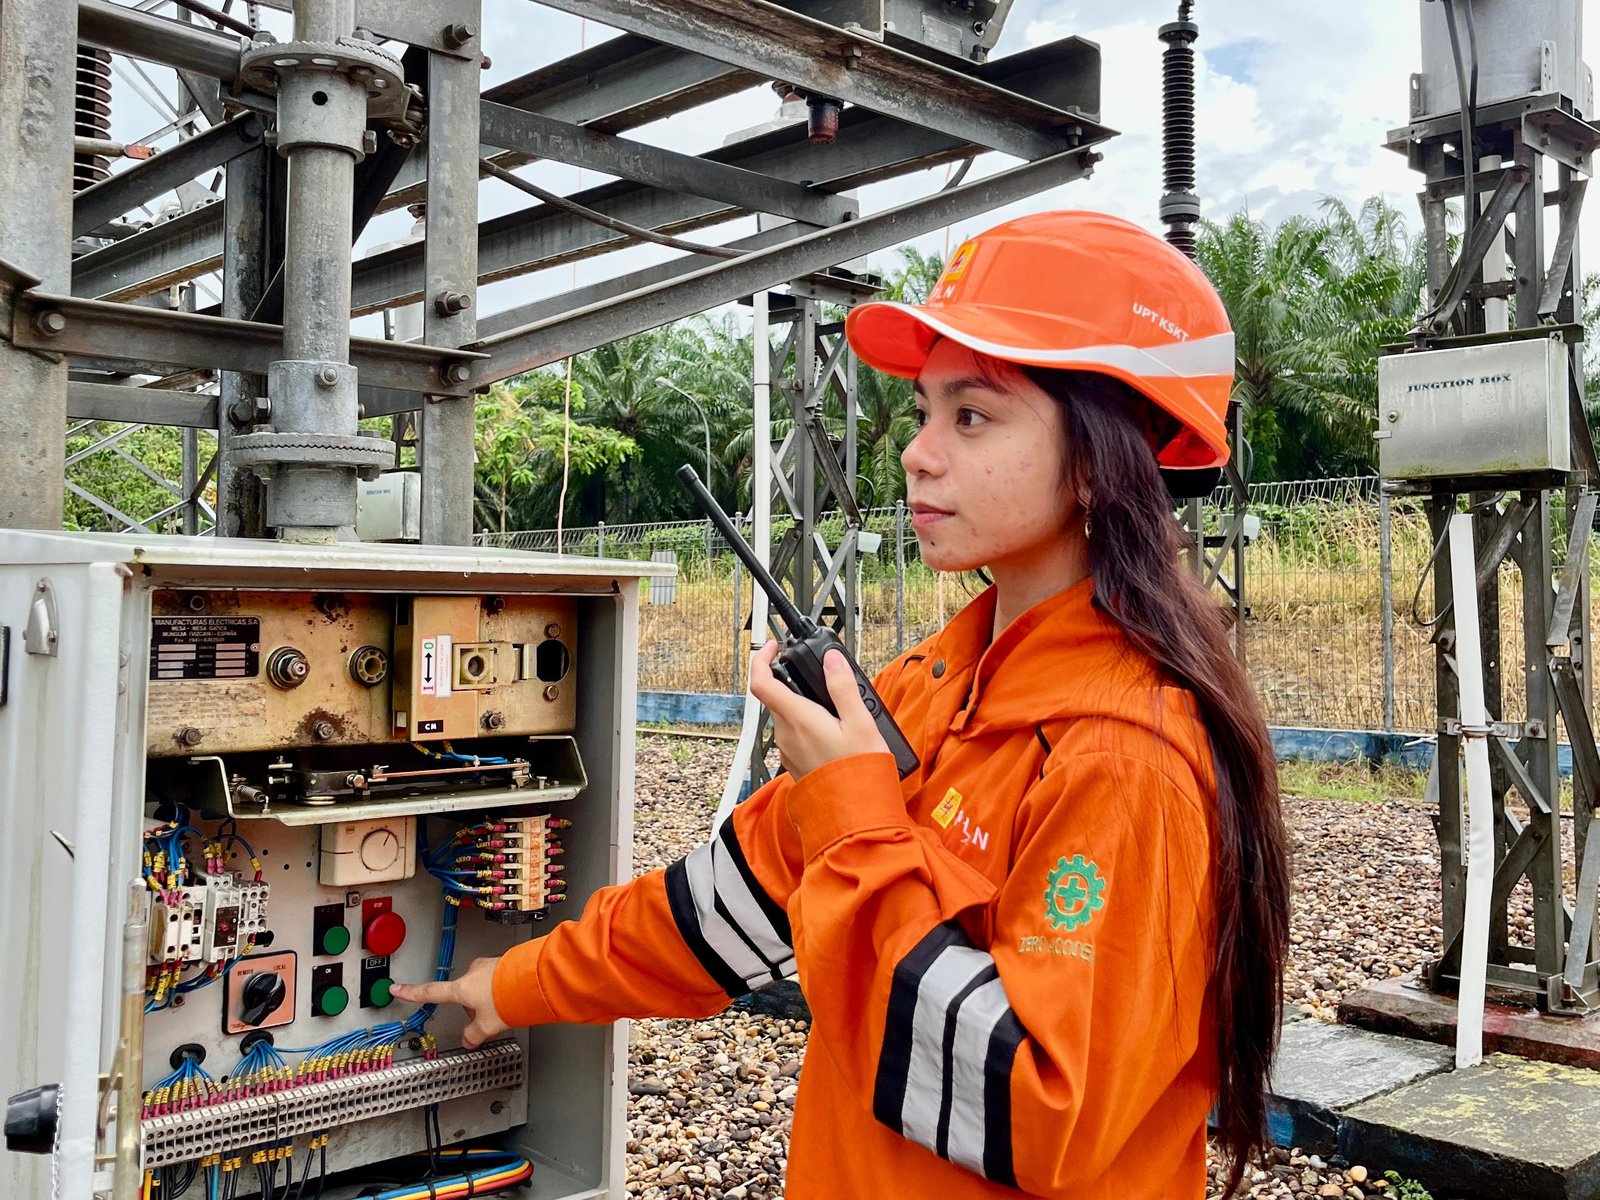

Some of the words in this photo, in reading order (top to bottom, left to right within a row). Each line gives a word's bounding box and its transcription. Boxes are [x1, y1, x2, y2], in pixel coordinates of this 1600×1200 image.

[1132, 301, 1159, 323] UPT
[1158, 317, 1189, 343] KSKT
[1406, 378, 1475, 393] JUNGTION
[1479, 374, 1512, 385] BOX
[1018, 935, 1046, 953] ZERO
[369, 958, 383, 967] OFF
